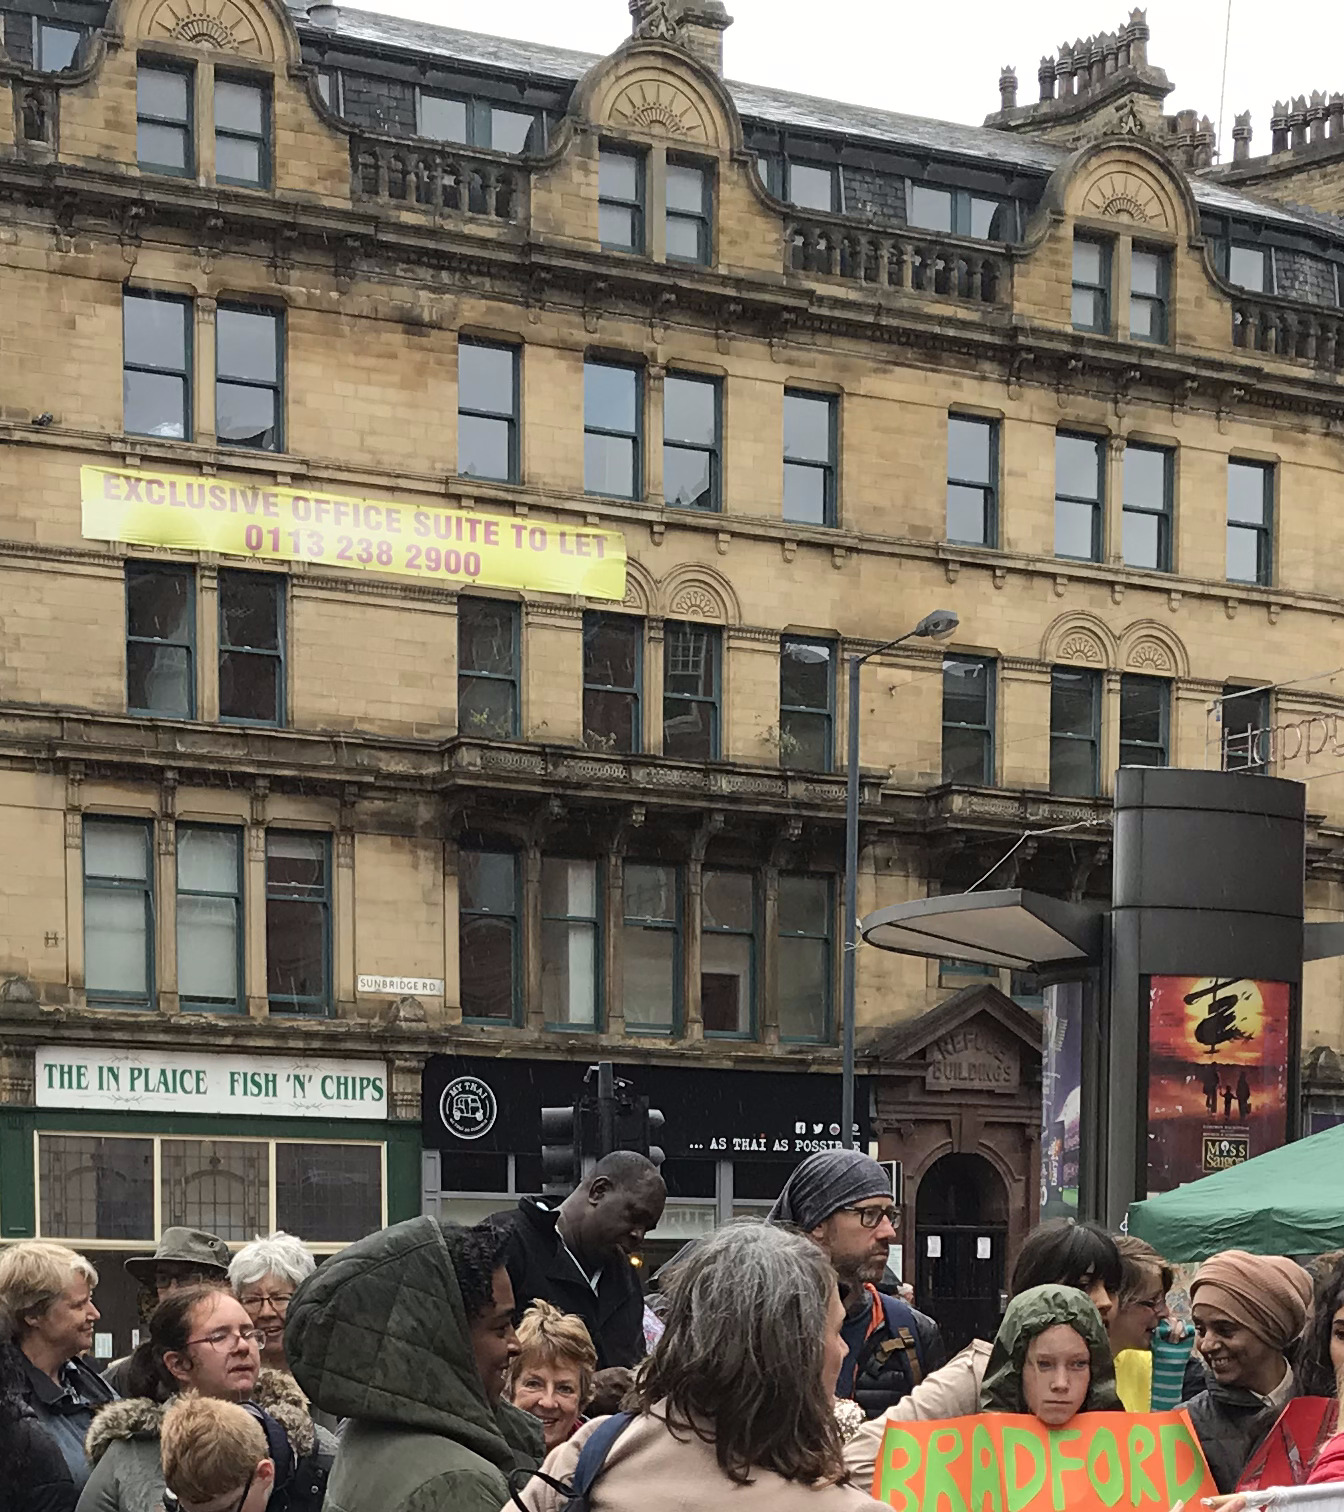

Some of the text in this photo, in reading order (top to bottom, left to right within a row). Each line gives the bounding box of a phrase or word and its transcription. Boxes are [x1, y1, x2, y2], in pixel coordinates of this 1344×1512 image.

[103, 473, 608, 558] EXCLUSIVE OFFICE SUITE TO LET
[245, 524, 481, 577] 0113 238 2900
[360, 978, 436, 992] SUNBRIDGE RD
[44, 1063, 89, 1090] THE
[97, 1065, 120, 1092] IN
[129, 1067, 208, 1095] PLAICE
[229, 1071, 277, 1098] FISH
[320, 1074, 384, 1101] CHIPS
[449, 1083, 462, 1097] MY
[710, 1138, 727, 1150] AS
[733, 1138, 767, 1151] THAI
[773, 1139, 789, 1151] AS
[795, 1140, 861, 1152] POSSIBE
